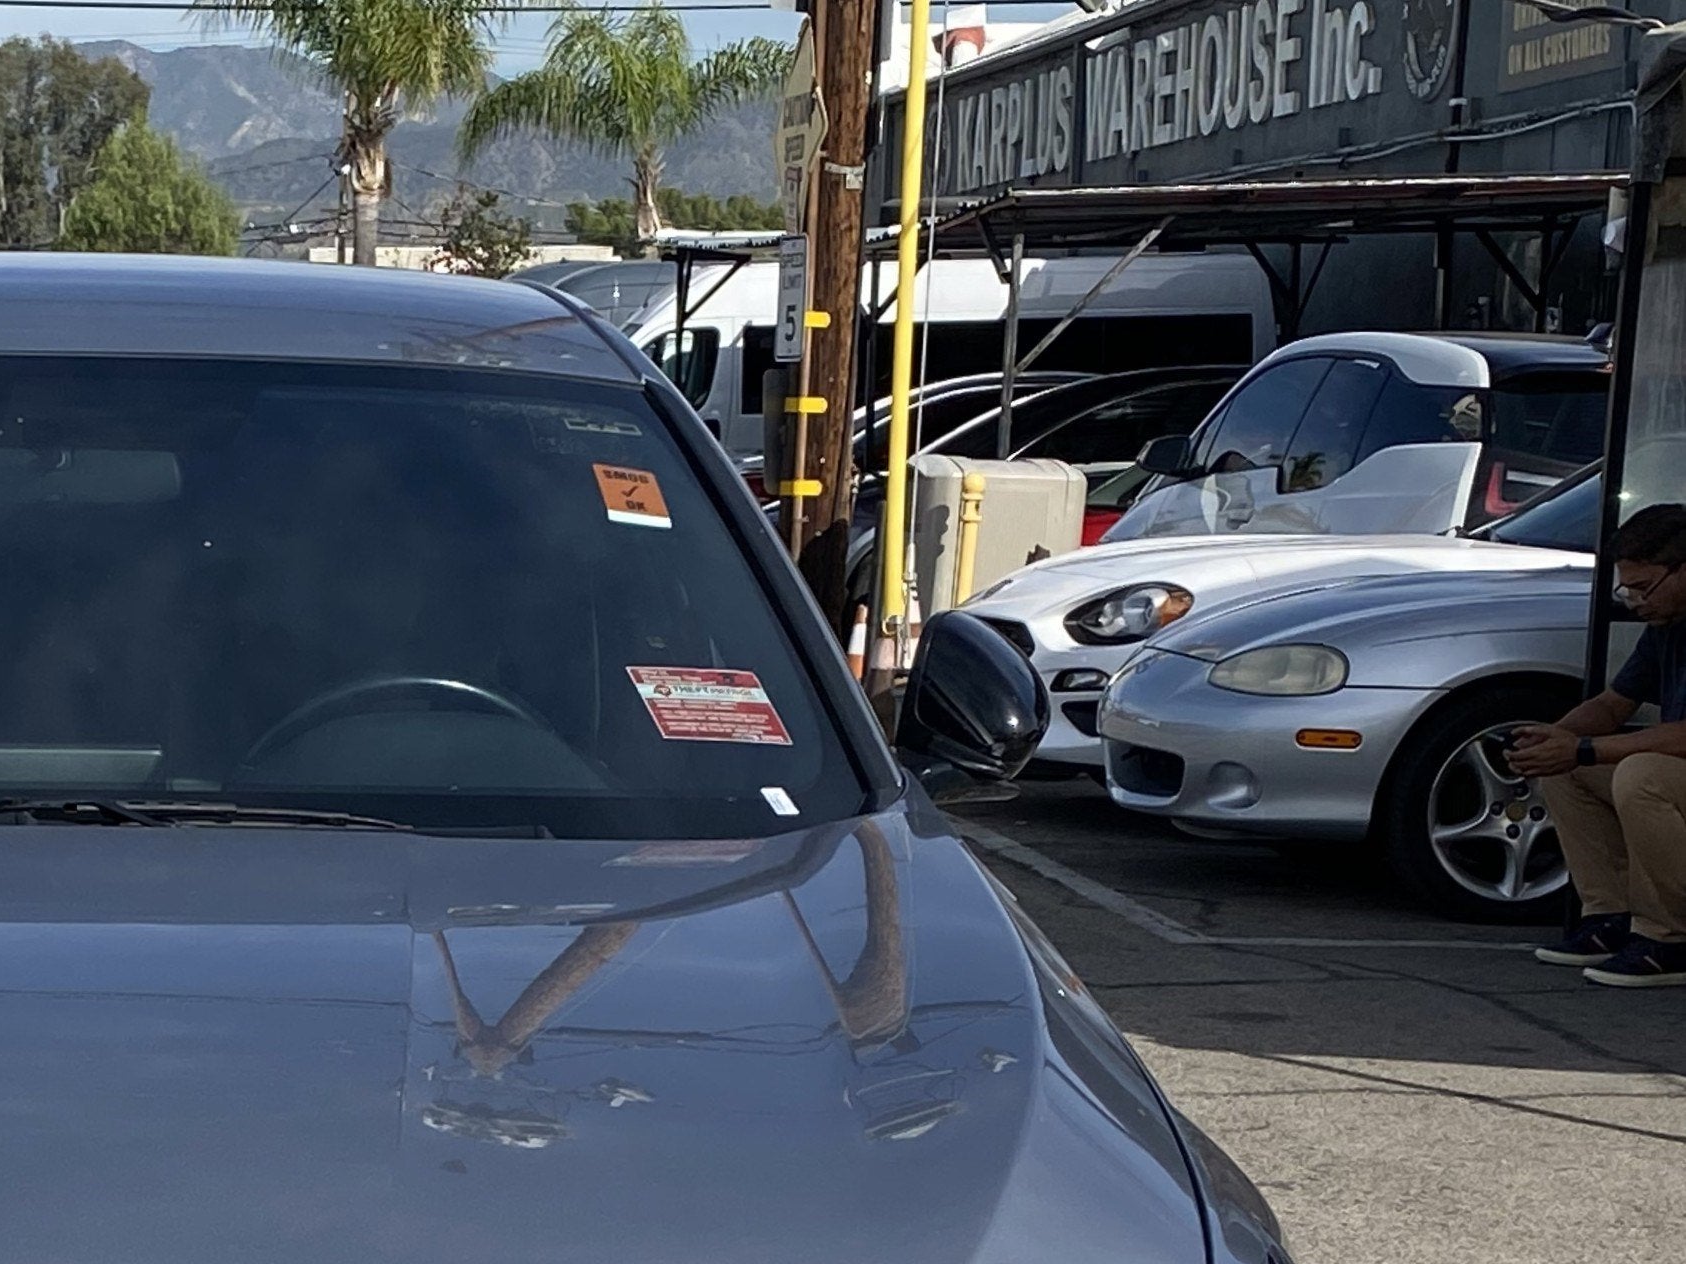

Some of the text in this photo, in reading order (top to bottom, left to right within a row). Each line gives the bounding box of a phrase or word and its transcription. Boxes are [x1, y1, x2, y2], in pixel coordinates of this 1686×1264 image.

[957, 66, 1074, 193] KARPLUS
[1086, 0, 1302, 162] WAREHOUSE
[1308, 0, 1382, 109] Inc.
[785, 305, 797, 342] 5
[603, 469, 649, 484] SMOG
[625, 499, 647, 512] OK
